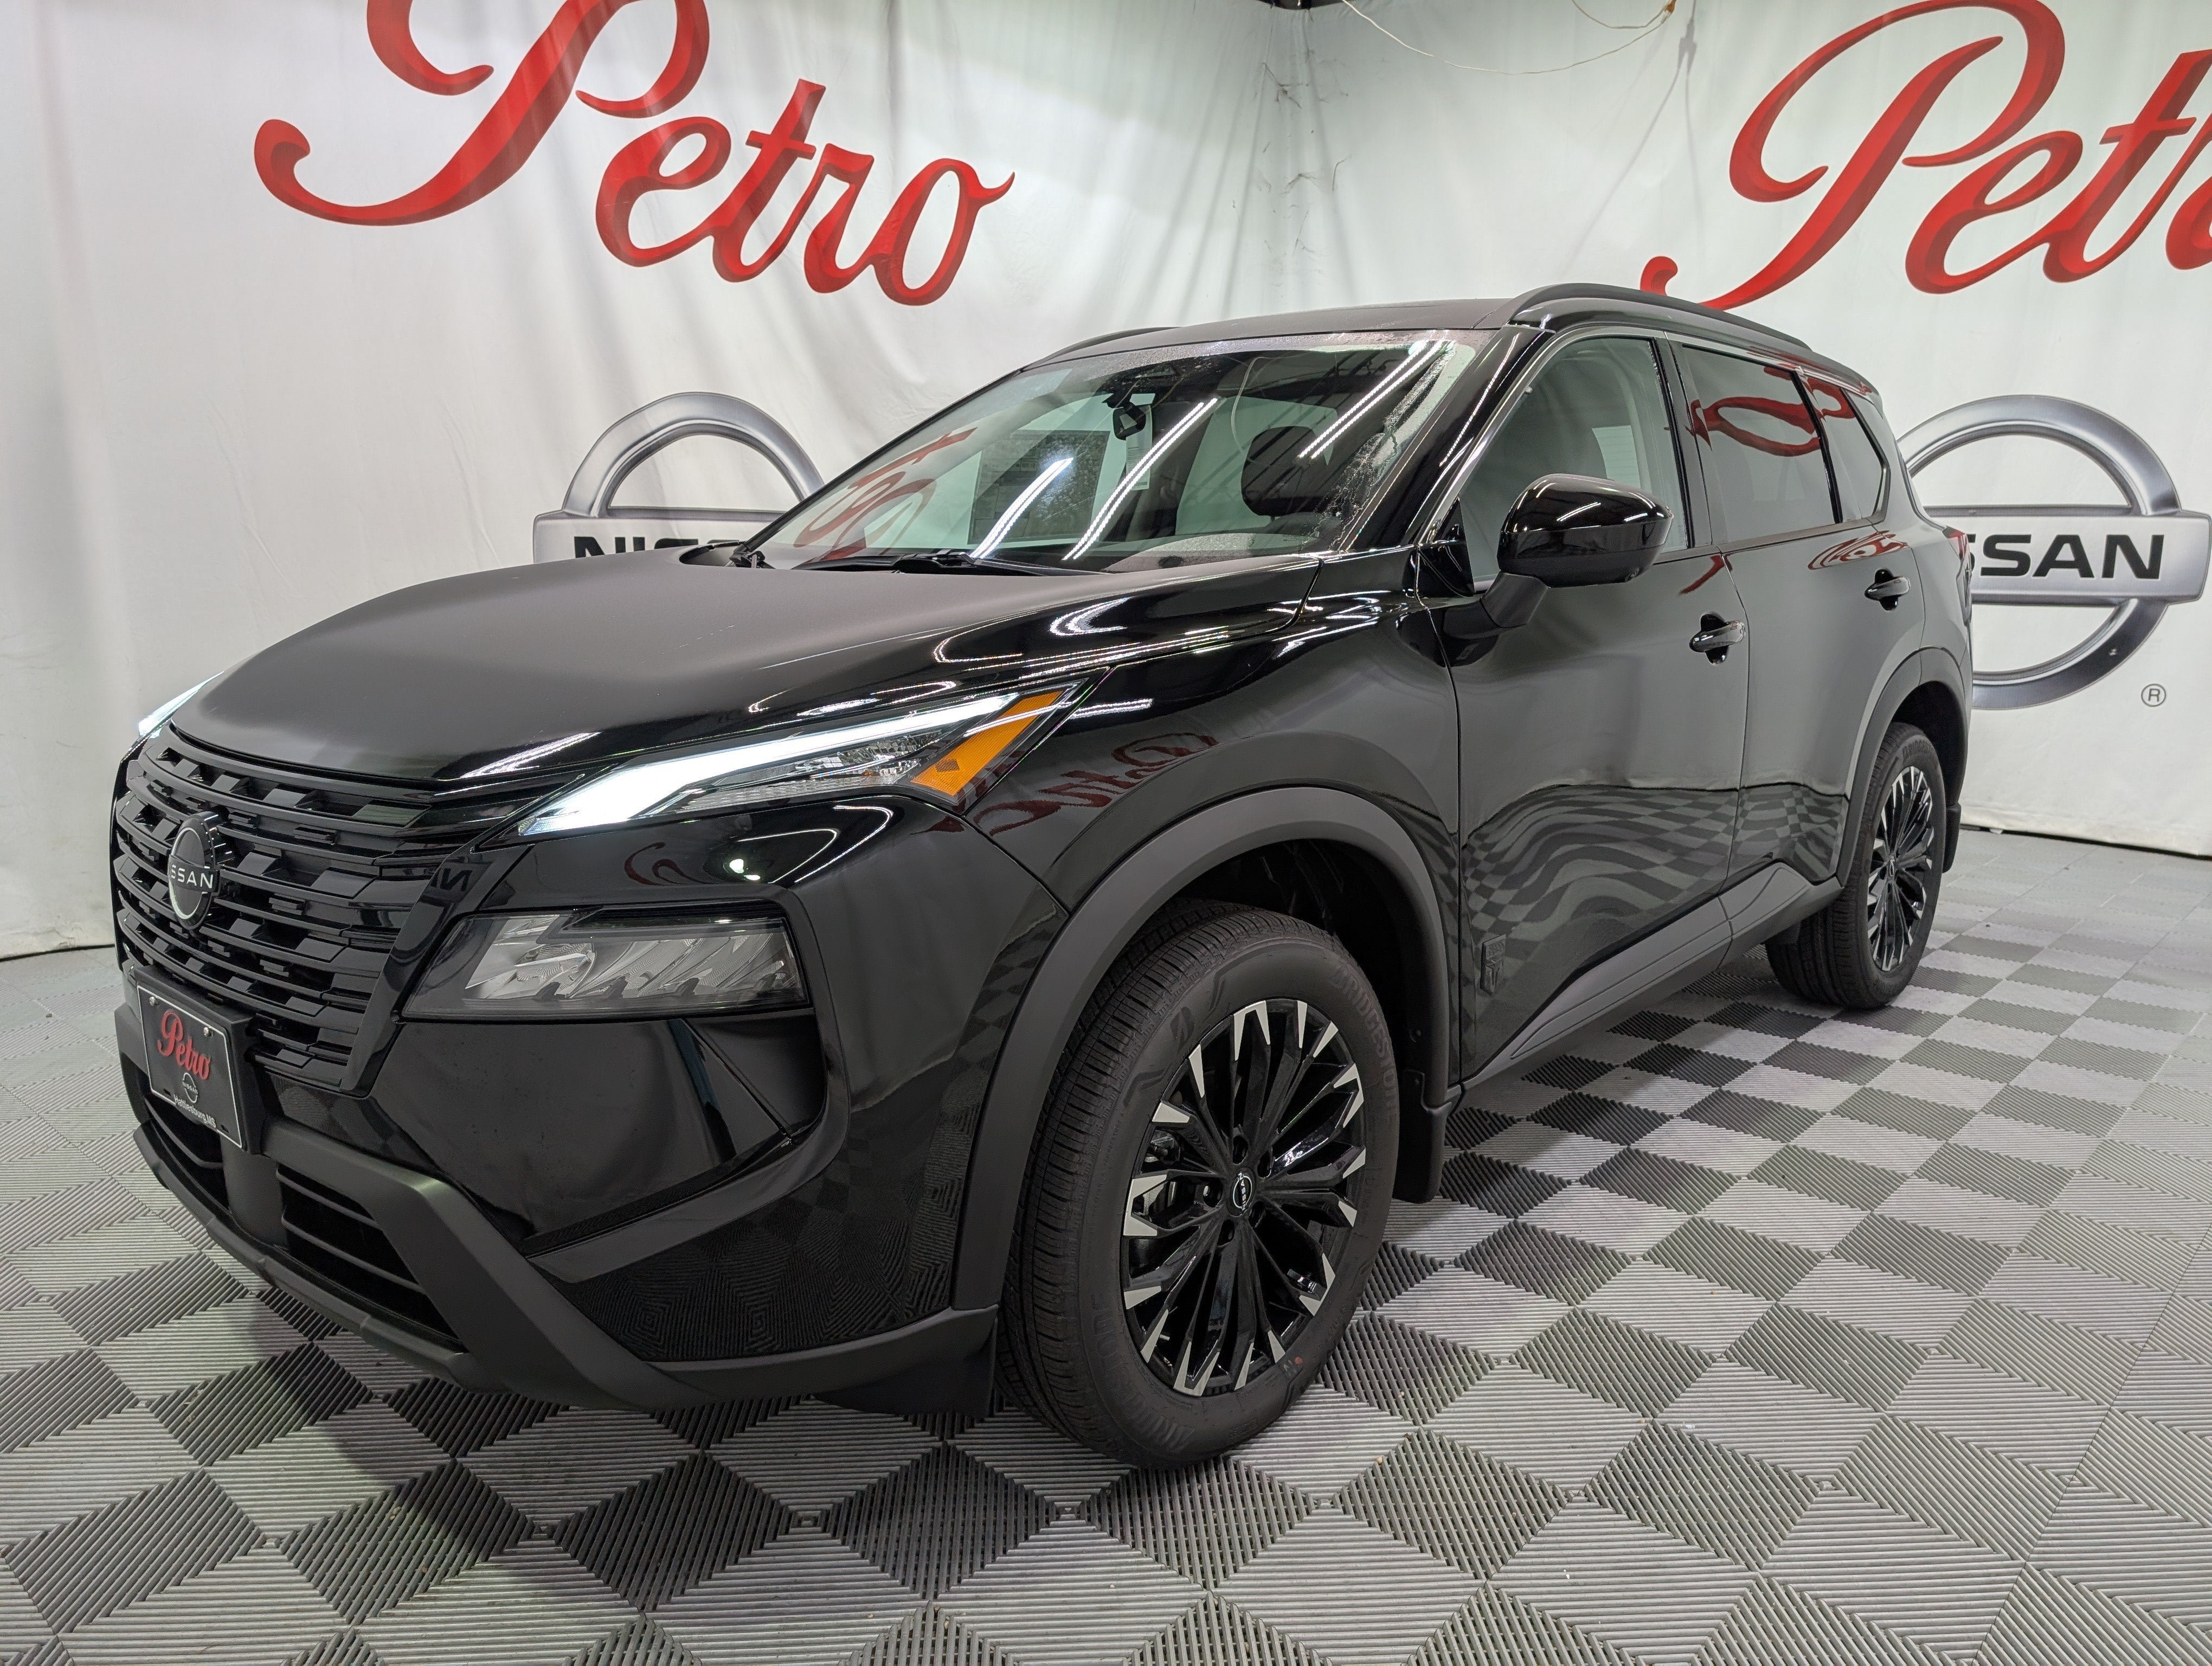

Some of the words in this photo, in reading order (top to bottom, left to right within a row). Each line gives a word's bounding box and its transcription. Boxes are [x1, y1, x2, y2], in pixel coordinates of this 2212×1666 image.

[253, 0, 1015, 306] Petro
[1966, 534, 2165, 580] SAN
[170, 864, 214, 889] SSAN
[157, 1010, 211, 1080] Petro
